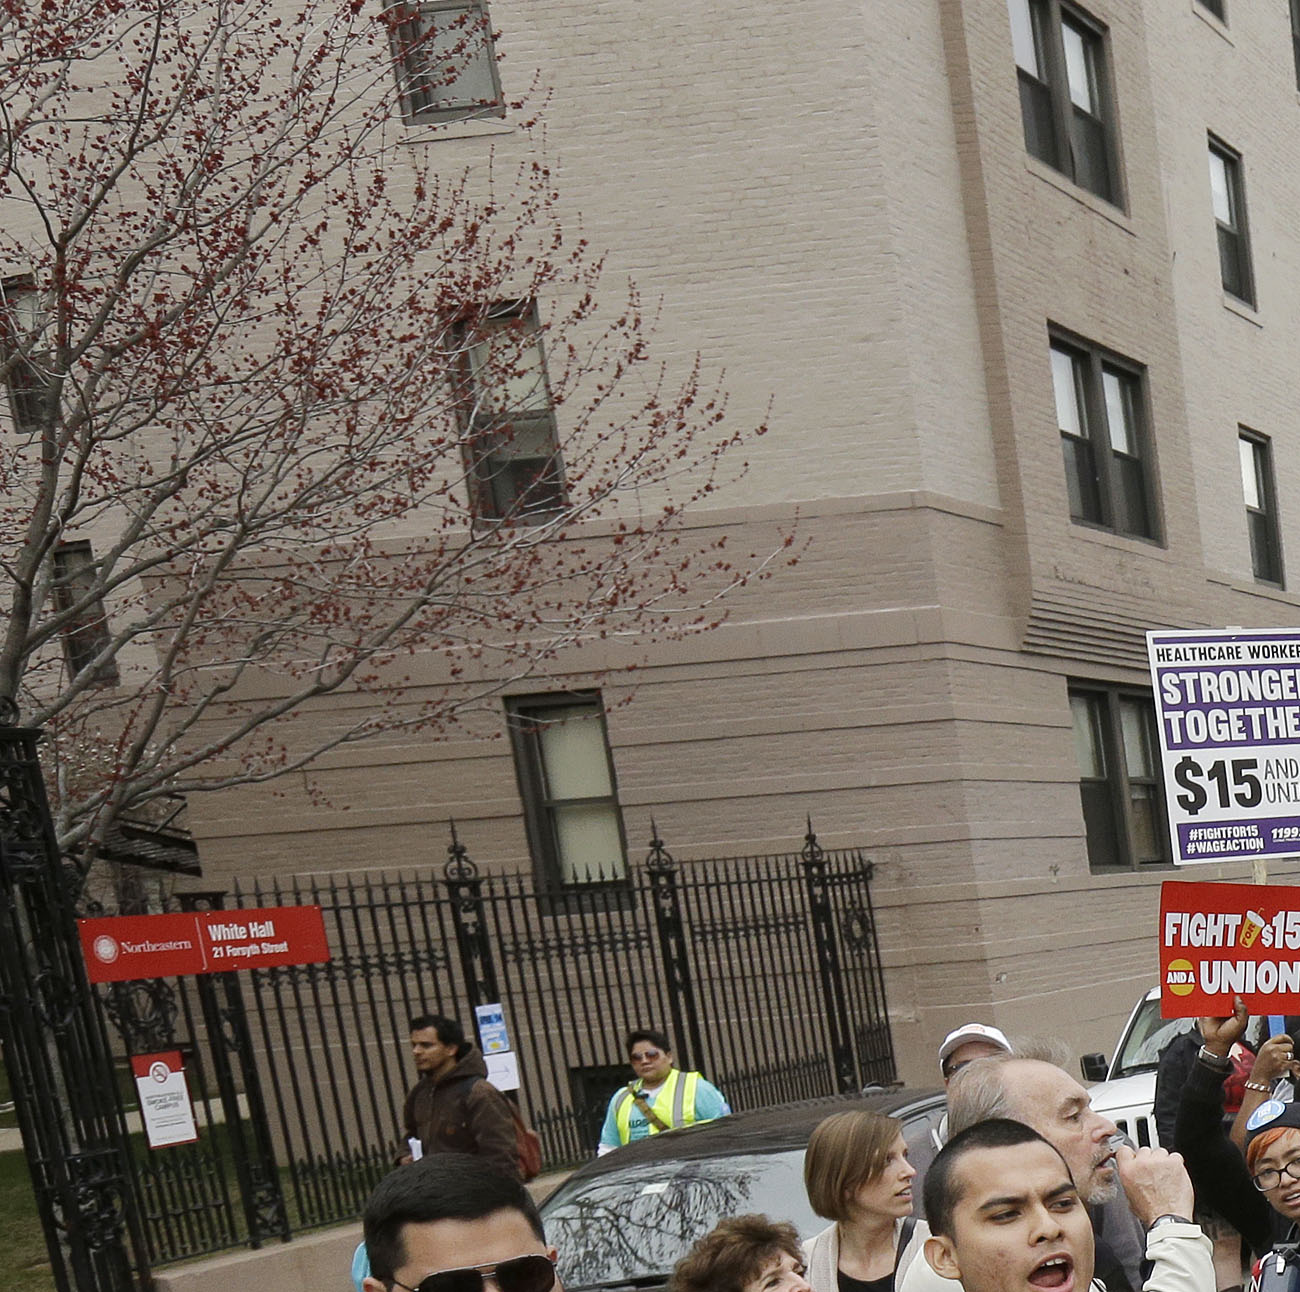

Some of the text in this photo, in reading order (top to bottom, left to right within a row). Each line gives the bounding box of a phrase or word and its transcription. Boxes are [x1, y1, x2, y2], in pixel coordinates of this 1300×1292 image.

[1156, 645, 1242, 662] HEALTHCARE
[1174, 756, 1263, 815] $15
[1189, 825, 1259, 841] #FIGHTFOR15
[1186, 837, 1264, 854] #WAGEACTION
[207, 920, 275, 942] White Hall
[1165, 912, 1242, 948] FIGHT
[121, 939, 192, 955] Northeastern
[212, 941, 288, 959] 21 Forsyth Street
[1166, 971, 1187, 984] AND
[1187, 971, 1196, 984] A
